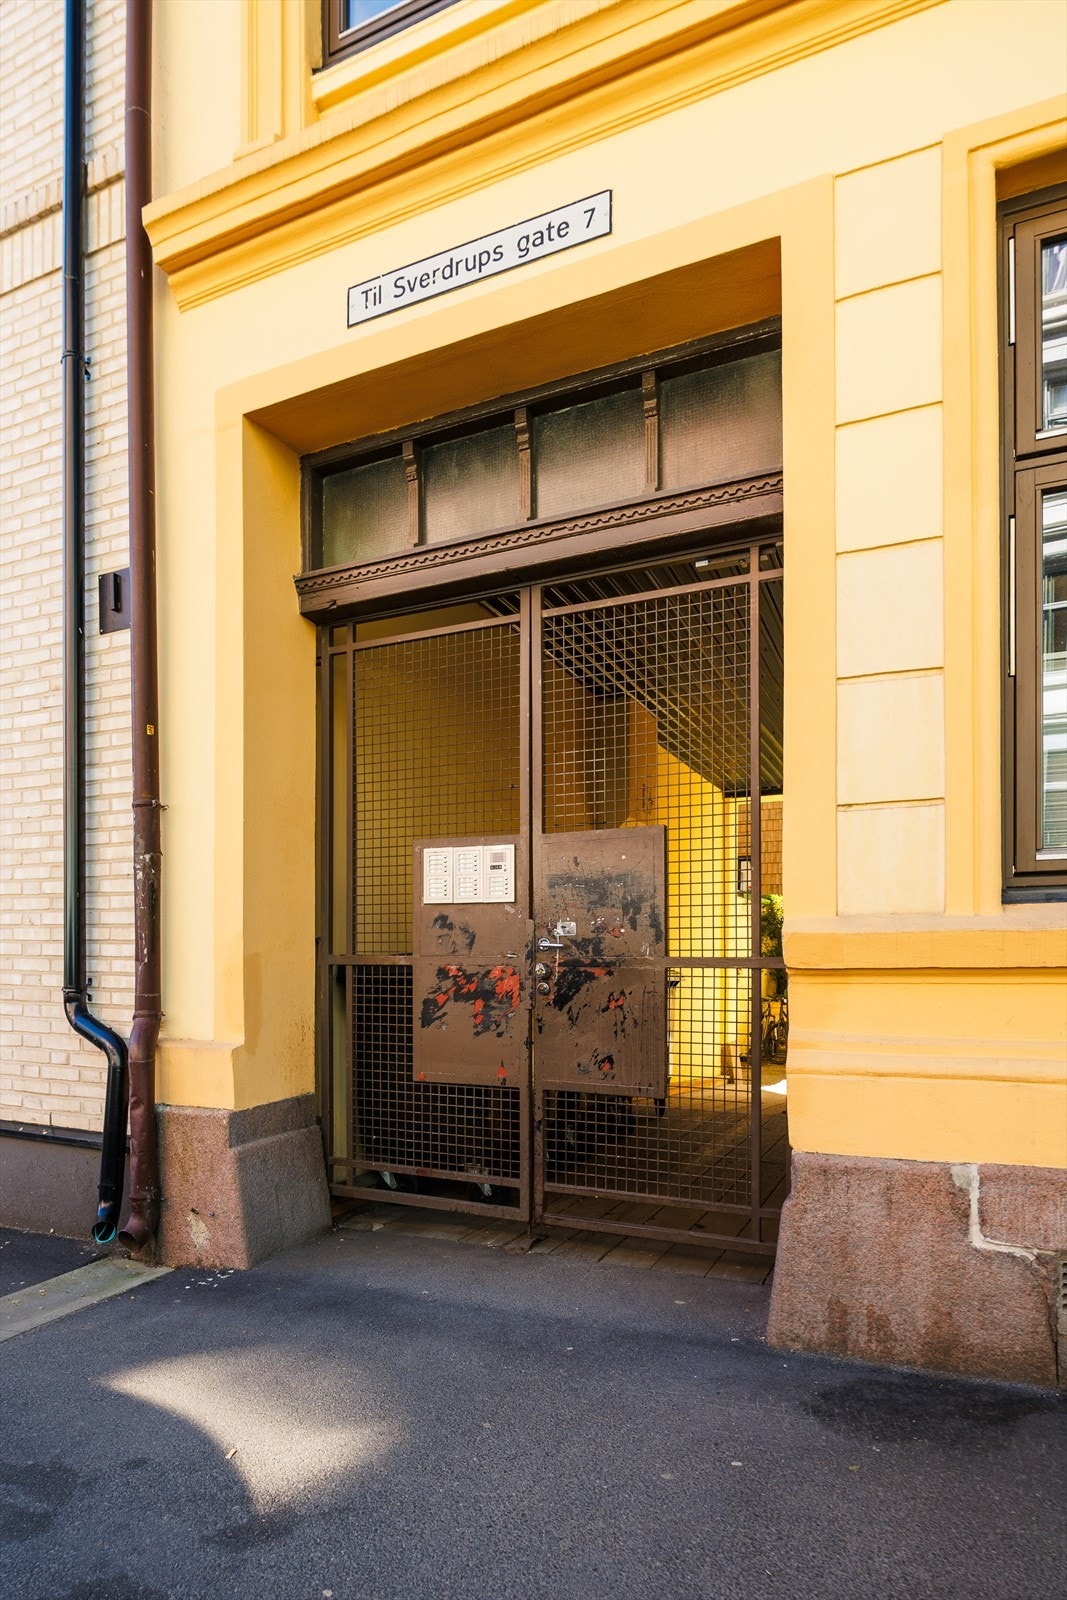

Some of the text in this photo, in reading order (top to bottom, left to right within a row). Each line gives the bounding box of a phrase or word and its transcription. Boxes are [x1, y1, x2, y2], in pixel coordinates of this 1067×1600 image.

[361, 207, 596, 310] Til Sverdrups gate 7
